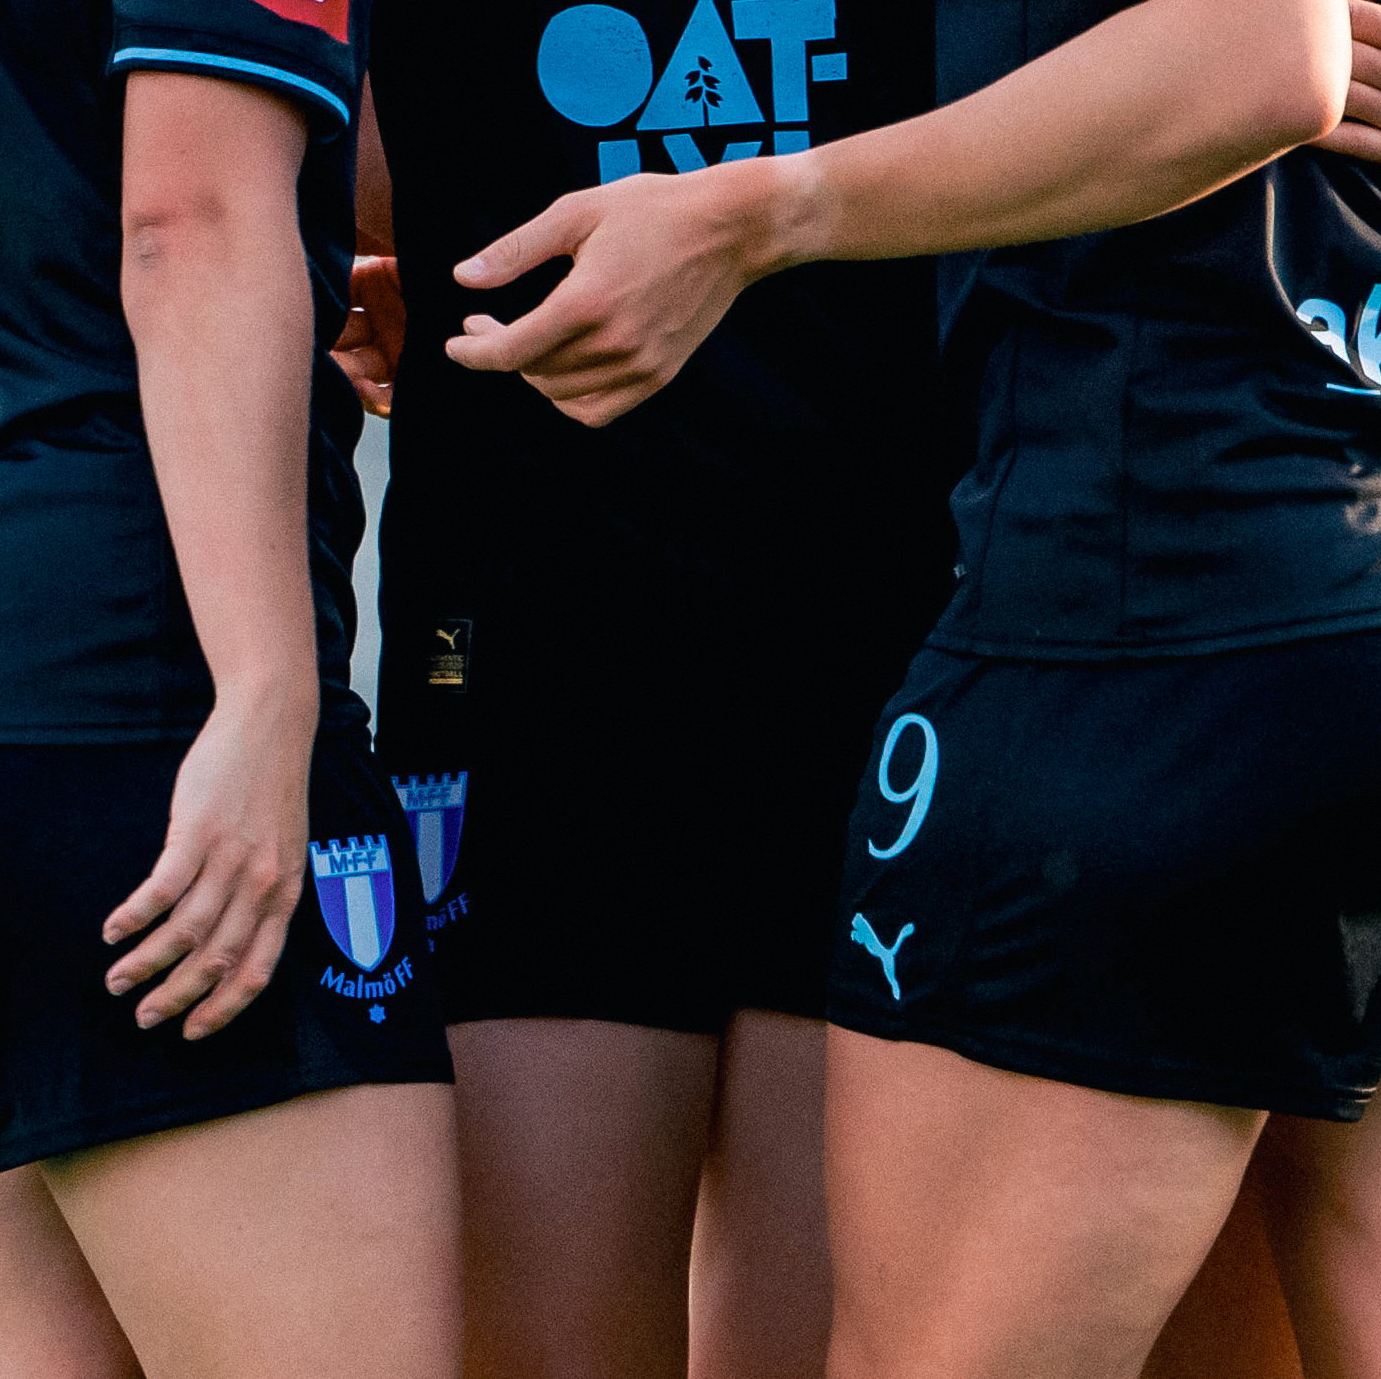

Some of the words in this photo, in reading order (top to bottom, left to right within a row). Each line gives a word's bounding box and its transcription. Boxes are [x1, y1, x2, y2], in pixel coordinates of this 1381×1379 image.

[868, 712, 939, 860] 9
[319, 965, 397, 1000] Malmö
[394, 955, 414, 988] FF
